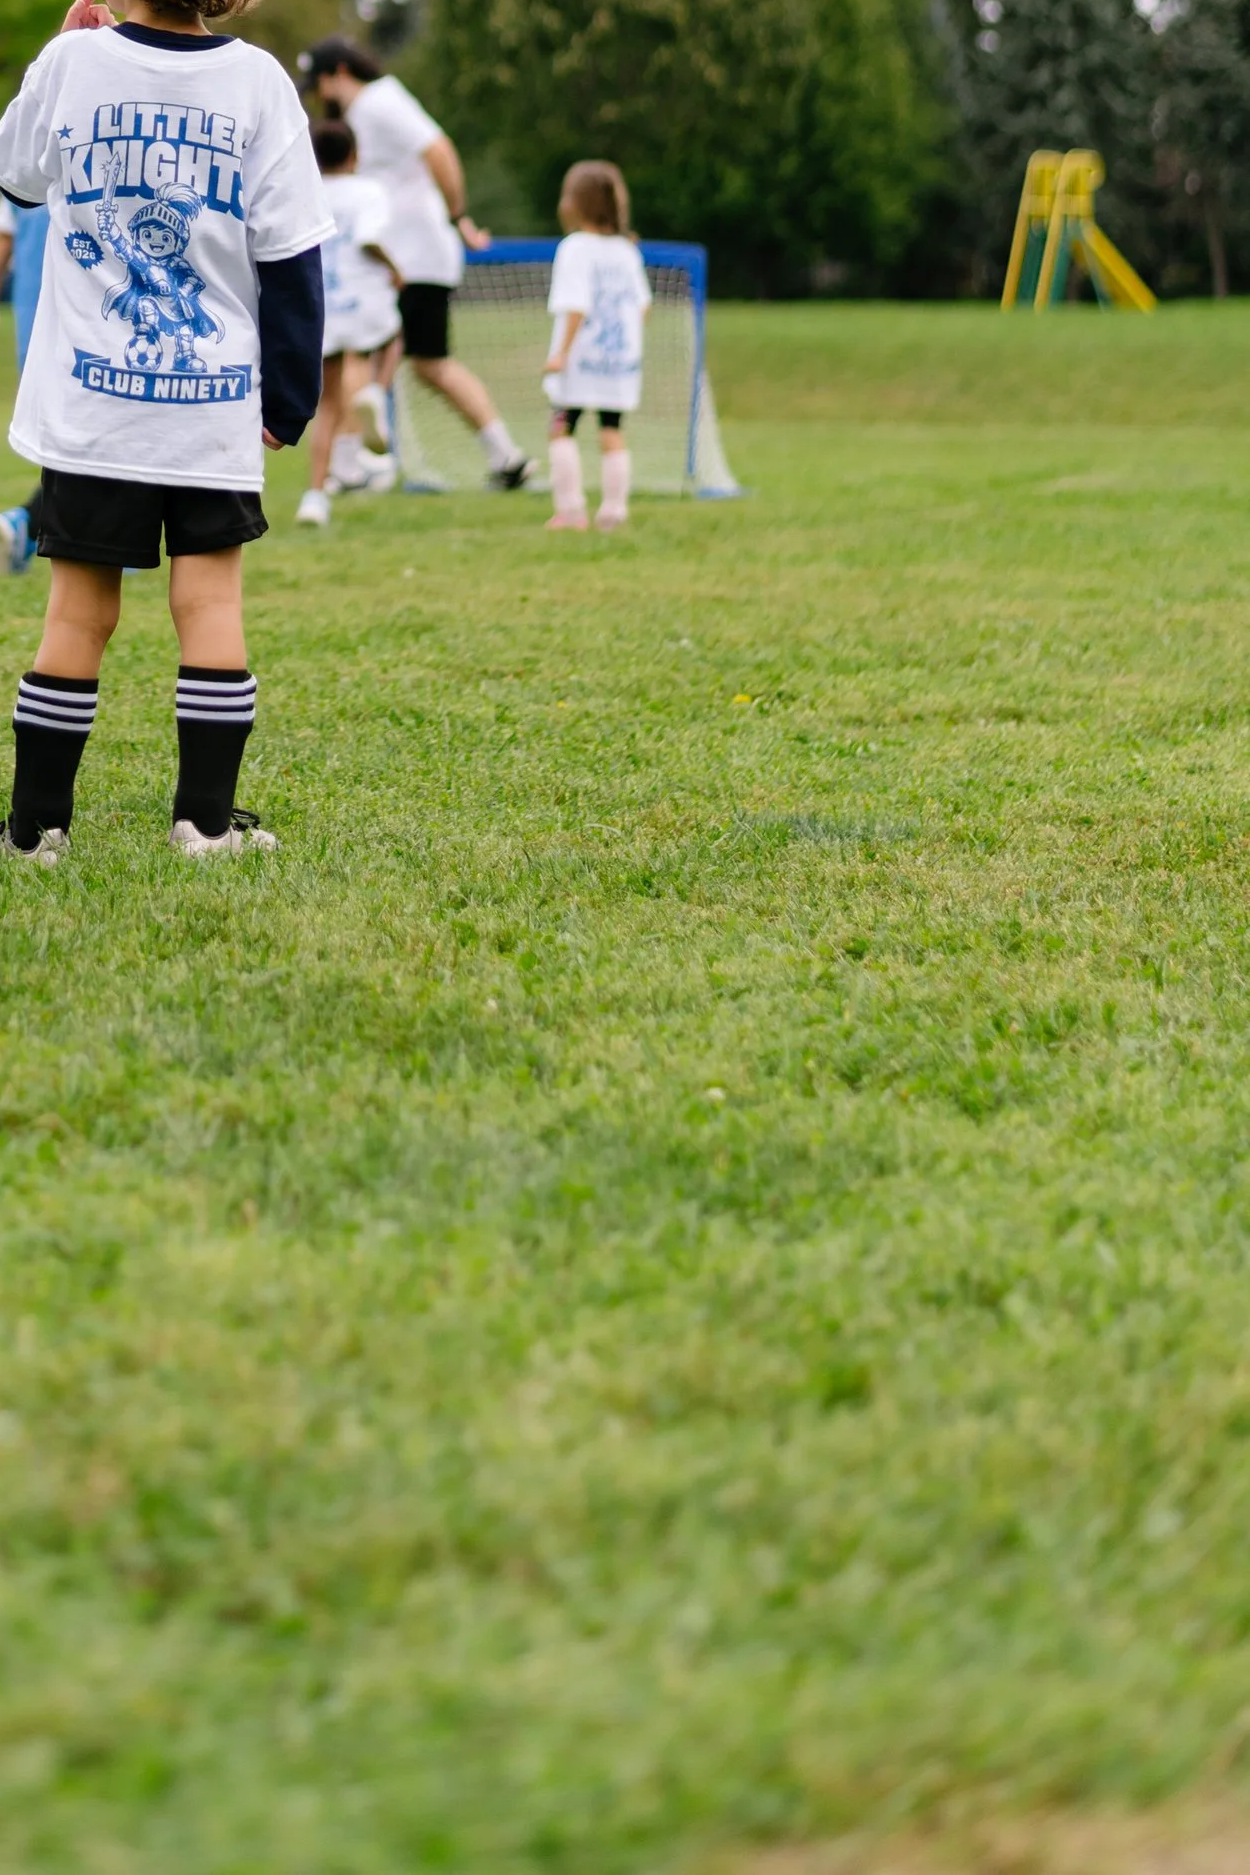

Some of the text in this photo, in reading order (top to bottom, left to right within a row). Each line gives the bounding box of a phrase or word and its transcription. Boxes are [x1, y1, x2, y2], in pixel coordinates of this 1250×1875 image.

[93, 102, 236, 153] LITTLE
[60, 139, 245, 219] KNIGHT
[72, 238, 94, 252] EST.
[88, 366, 241, 400] CLUB NINETY
